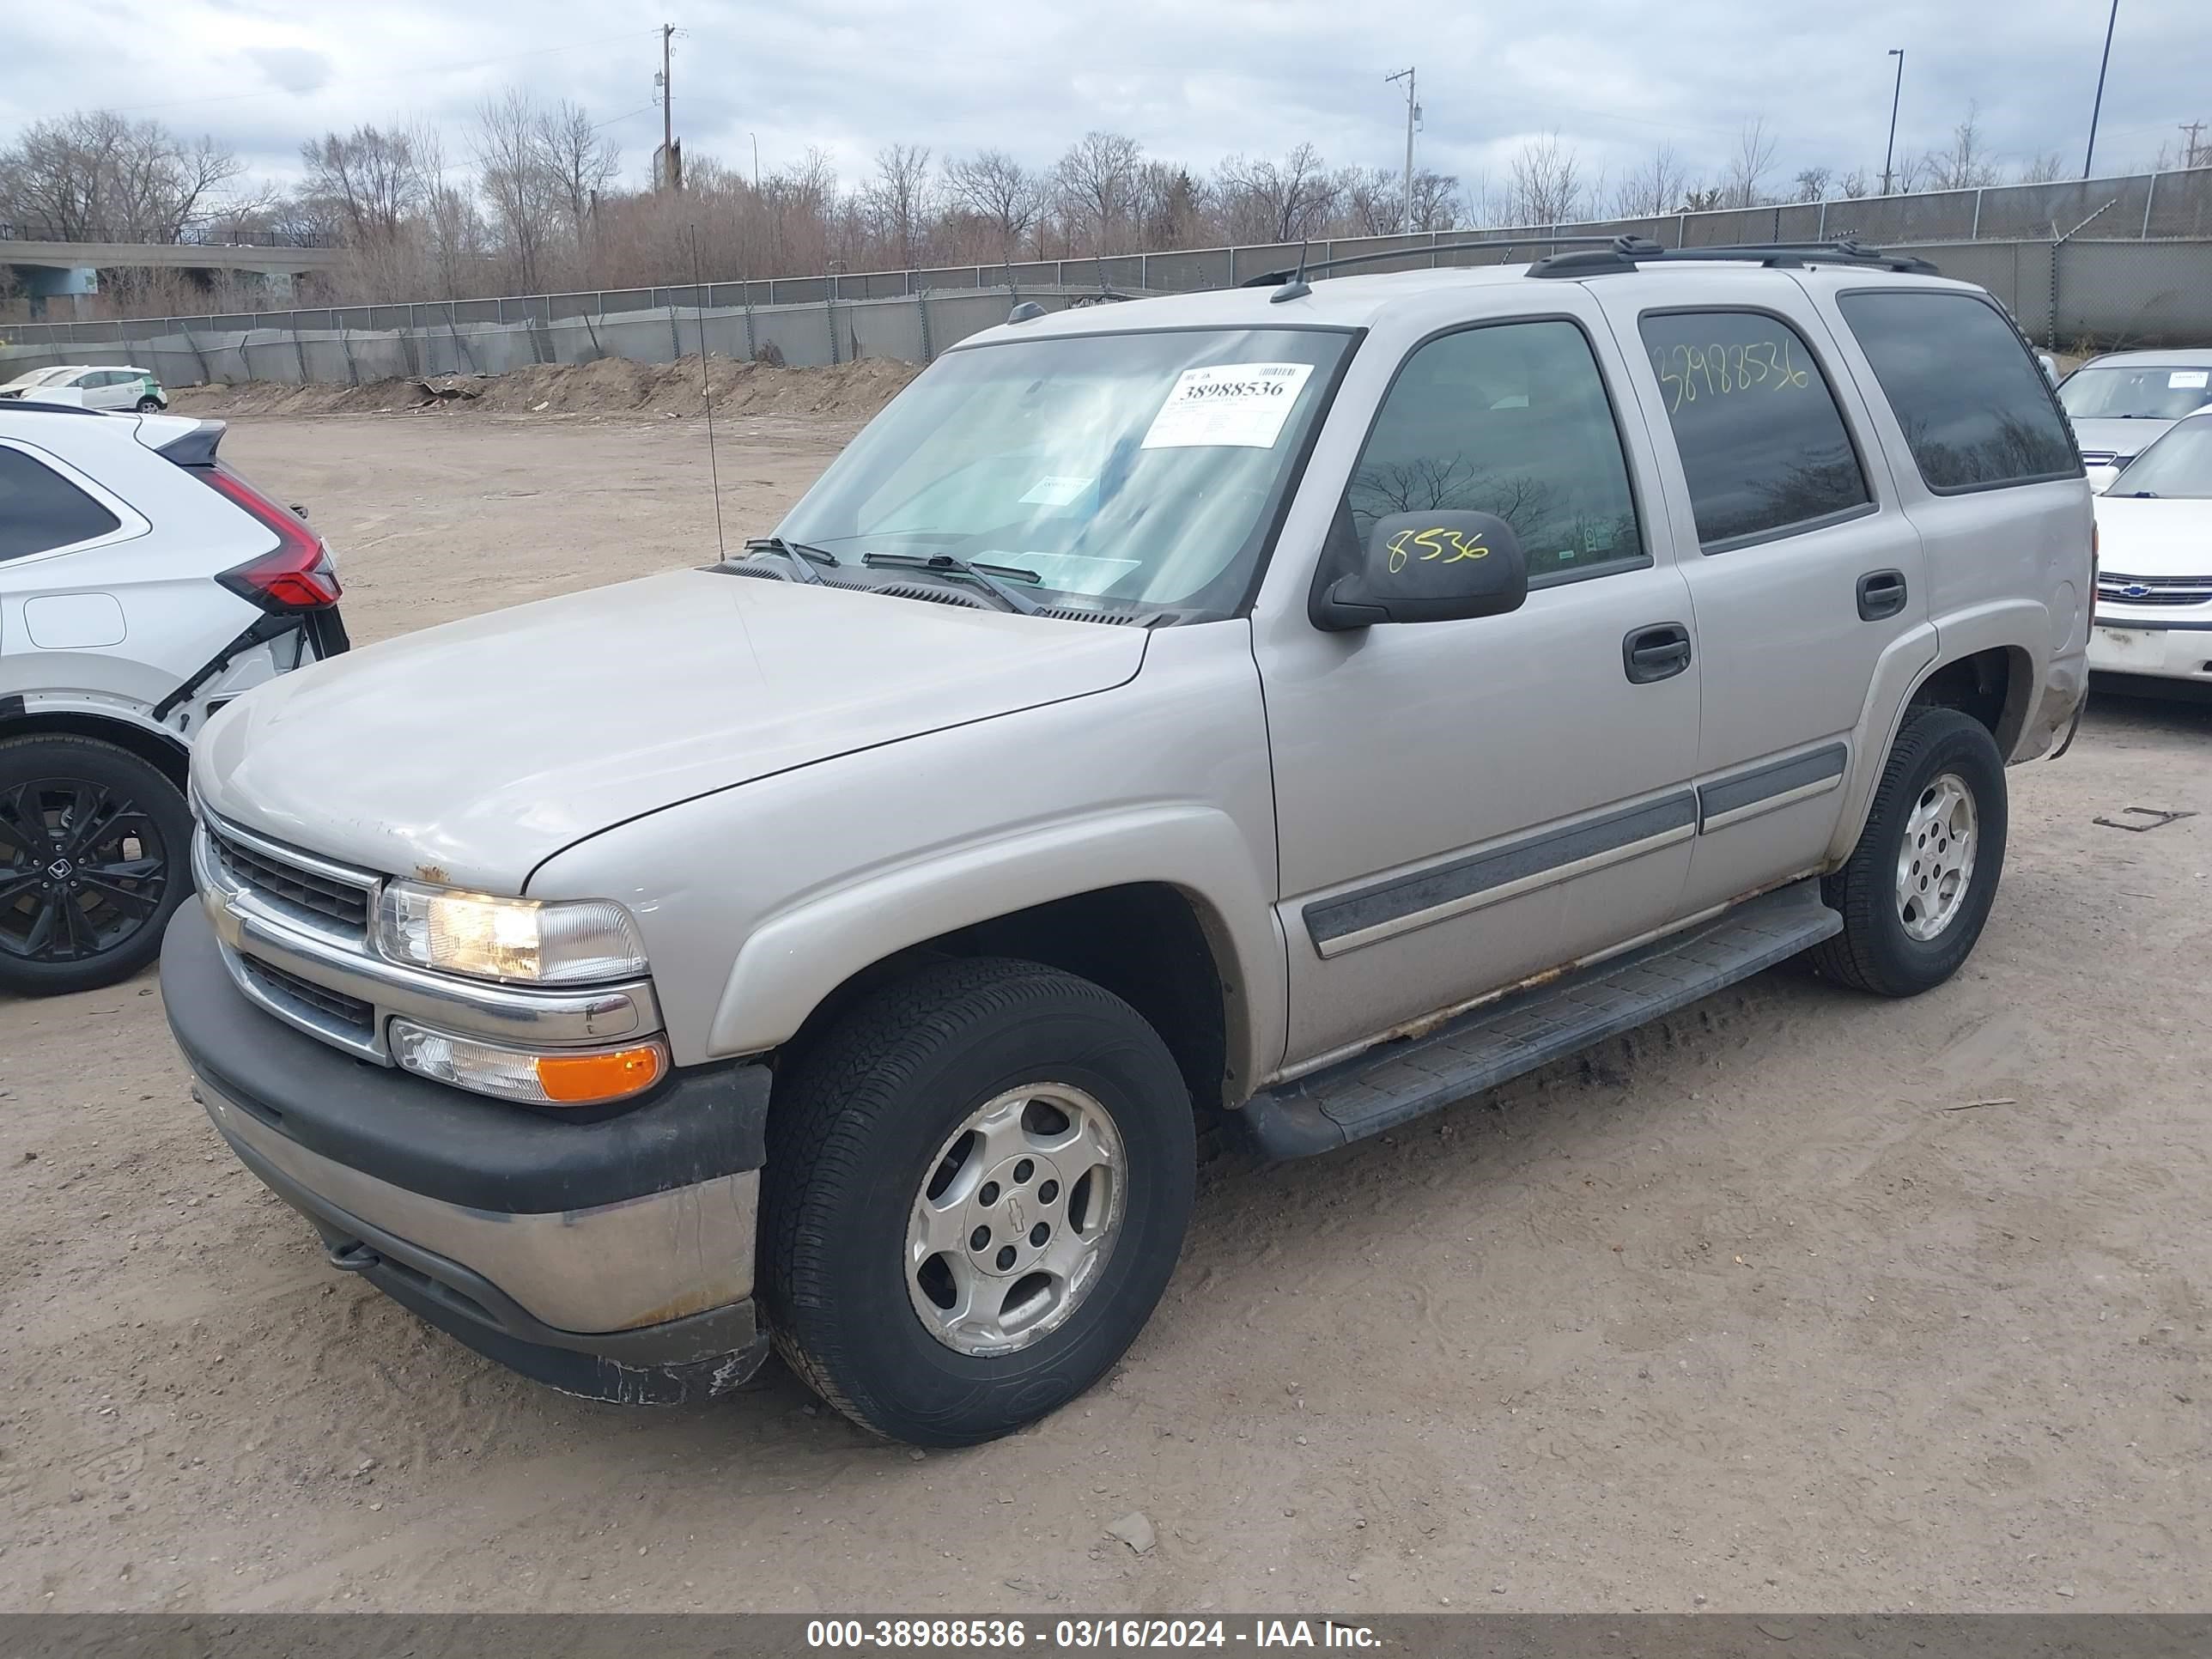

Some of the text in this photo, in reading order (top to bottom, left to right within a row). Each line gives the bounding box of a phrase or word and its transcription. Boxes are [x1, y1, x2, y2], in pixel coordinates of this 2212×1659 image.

[1180, 381, 1285, 400] 38988536
[1654, 338, 1808, 414] 38988536
[1386, 528, 1489, 574] 8536
